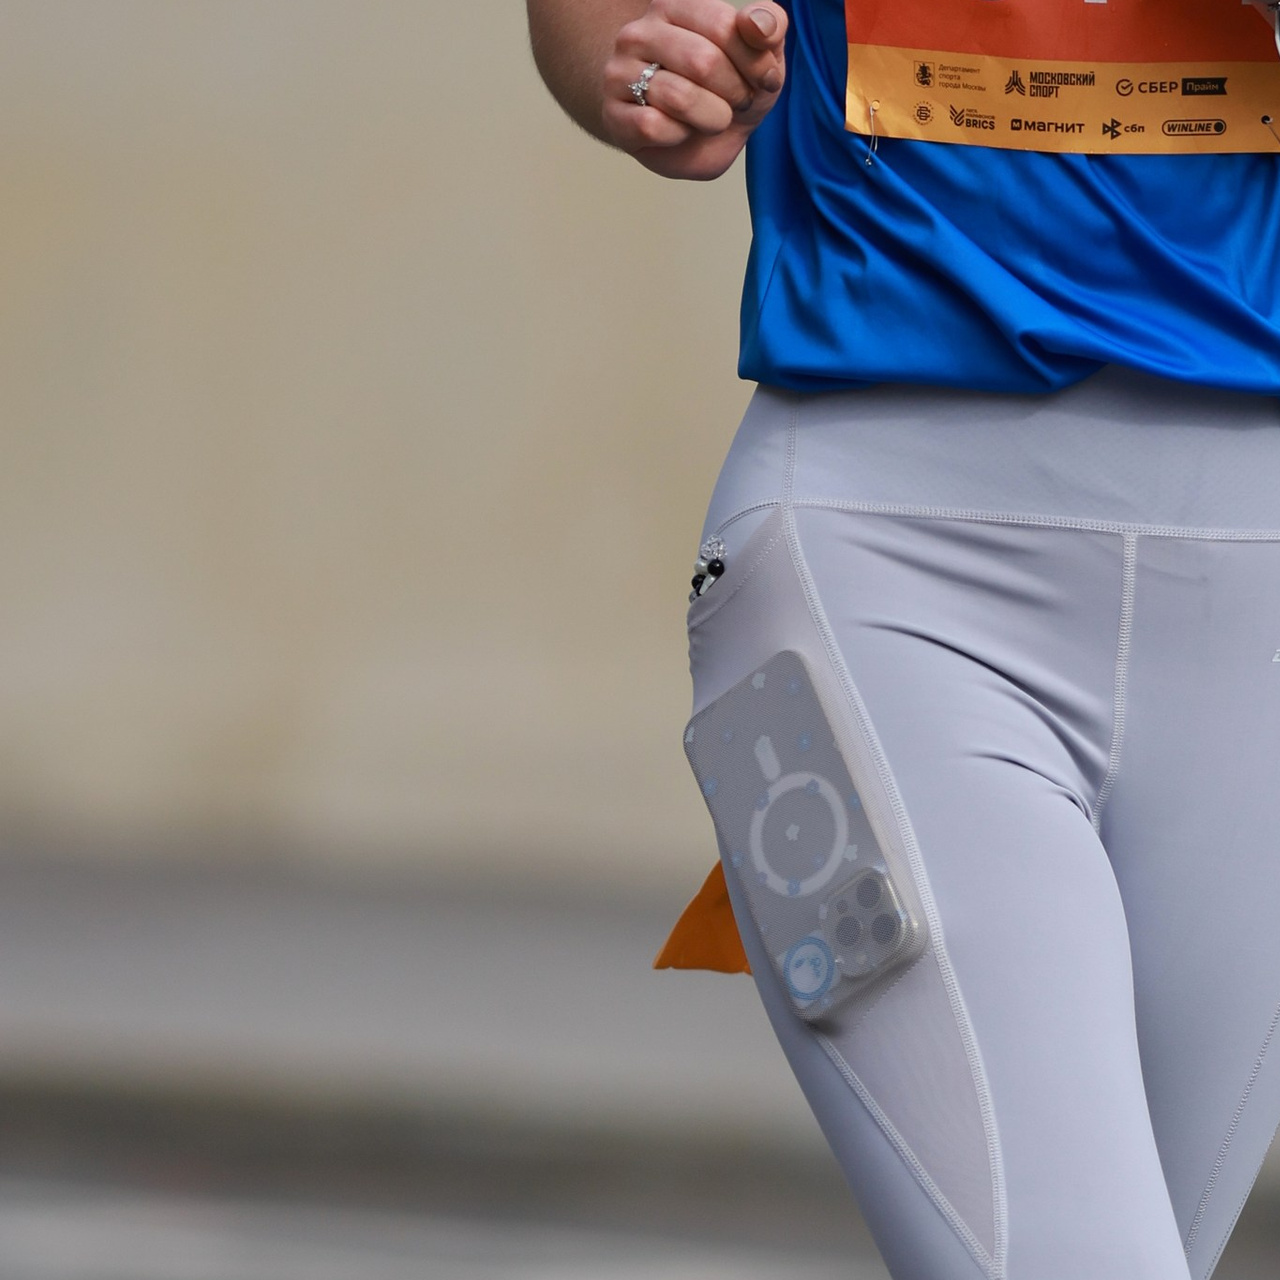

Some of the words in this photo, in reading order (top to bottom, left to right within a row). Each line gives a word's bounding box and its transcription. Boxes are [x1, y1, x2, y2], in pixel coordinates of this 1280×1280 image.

[1029, 71, 1096, 87] МОСКОВСКИЙ
[1029, 84, 1060, 99] СПОРТ
[1137, 81, 1179, 94] СБЕР
[1186, 81, 1220, 93] Прайм
[965, 119, 996, 131] BRICS
[1123, 123, 1145, 134] сбп
[1166, 122, 1213, 133] WINLINE
